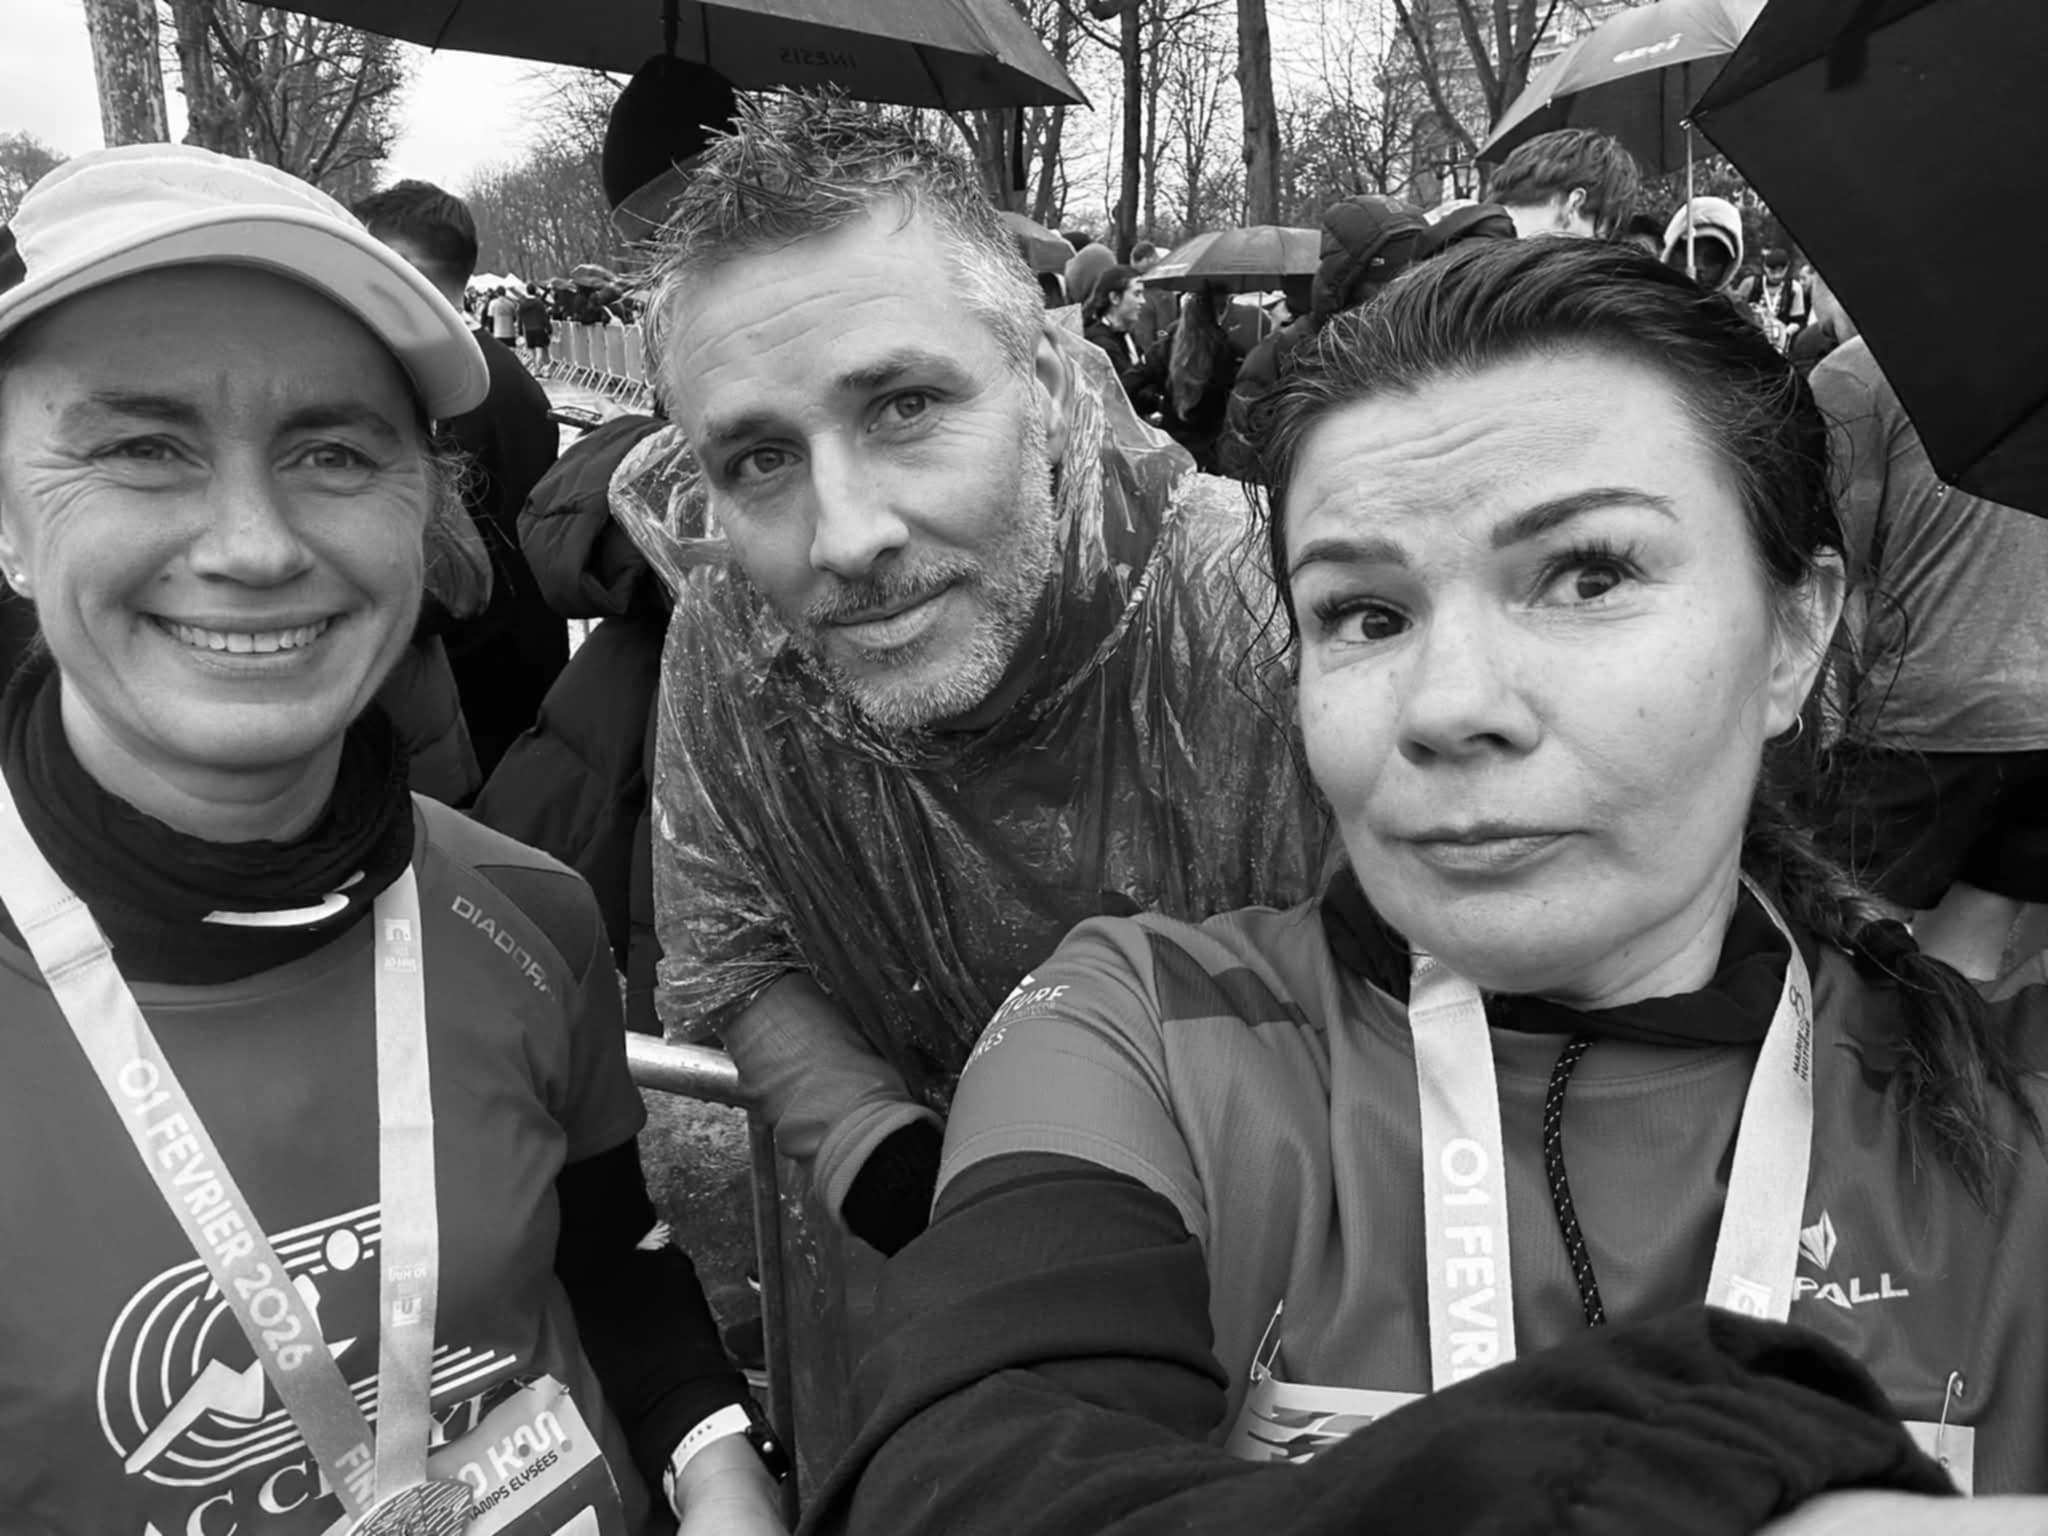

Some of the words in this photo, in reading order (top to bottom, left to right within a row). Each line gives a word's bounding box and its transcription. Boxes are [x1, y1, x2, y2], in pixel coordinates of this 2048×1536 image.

[146, 1112, 255, 1267] FEVRIER
[233, 1262, 313, 1371] 2026
[471, 1486, 510, 1520] AMPS
[509, 1450, 559, 1491] ELYSÉES
